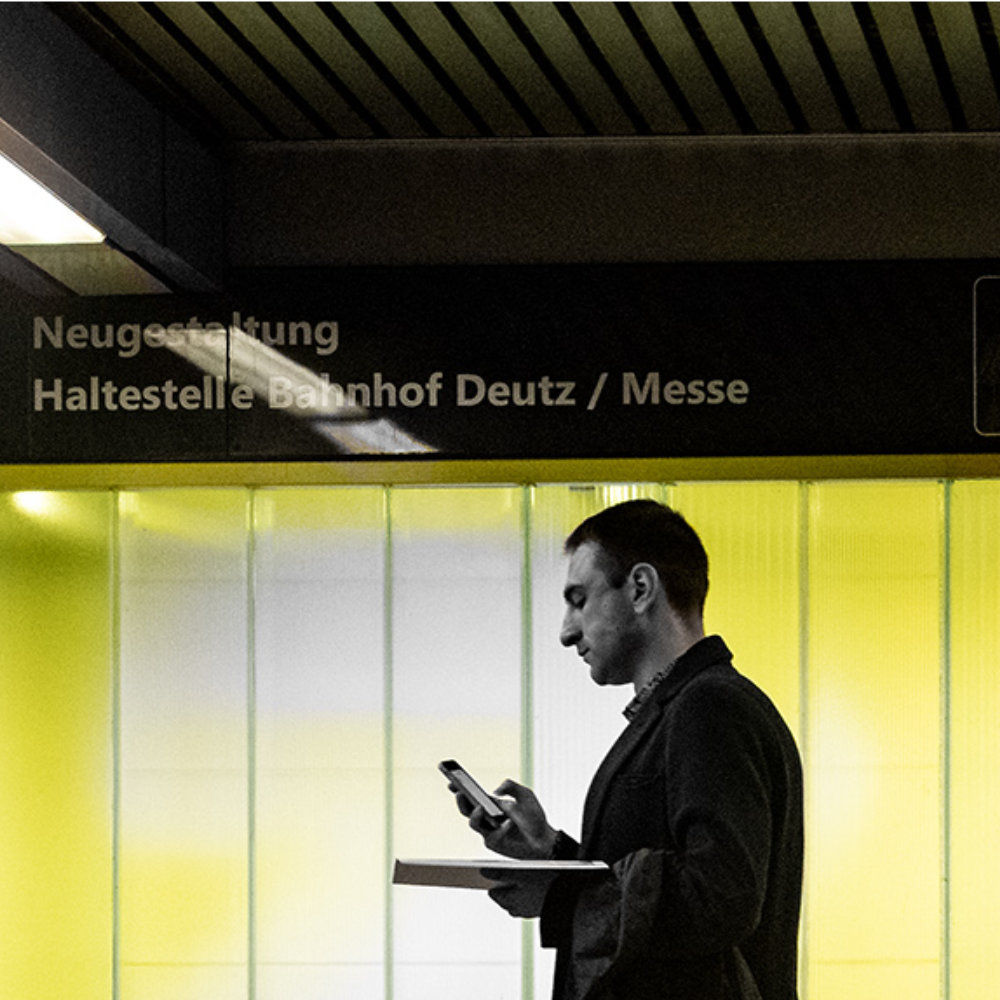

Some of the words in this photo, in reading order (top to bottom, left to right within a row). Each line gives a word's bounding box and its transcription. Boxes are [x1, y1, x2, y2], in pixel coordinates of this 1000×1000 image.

[32, 311, 340, 359] Neugestaltung
[33, 375, 254, 412] Haltestelle
[268, 371, 444, 411] Bahnhof
[455, 372, 577, 407] Deutz
[586, 371, 609, 411] /
[622, 371, 750, 406] Messe
